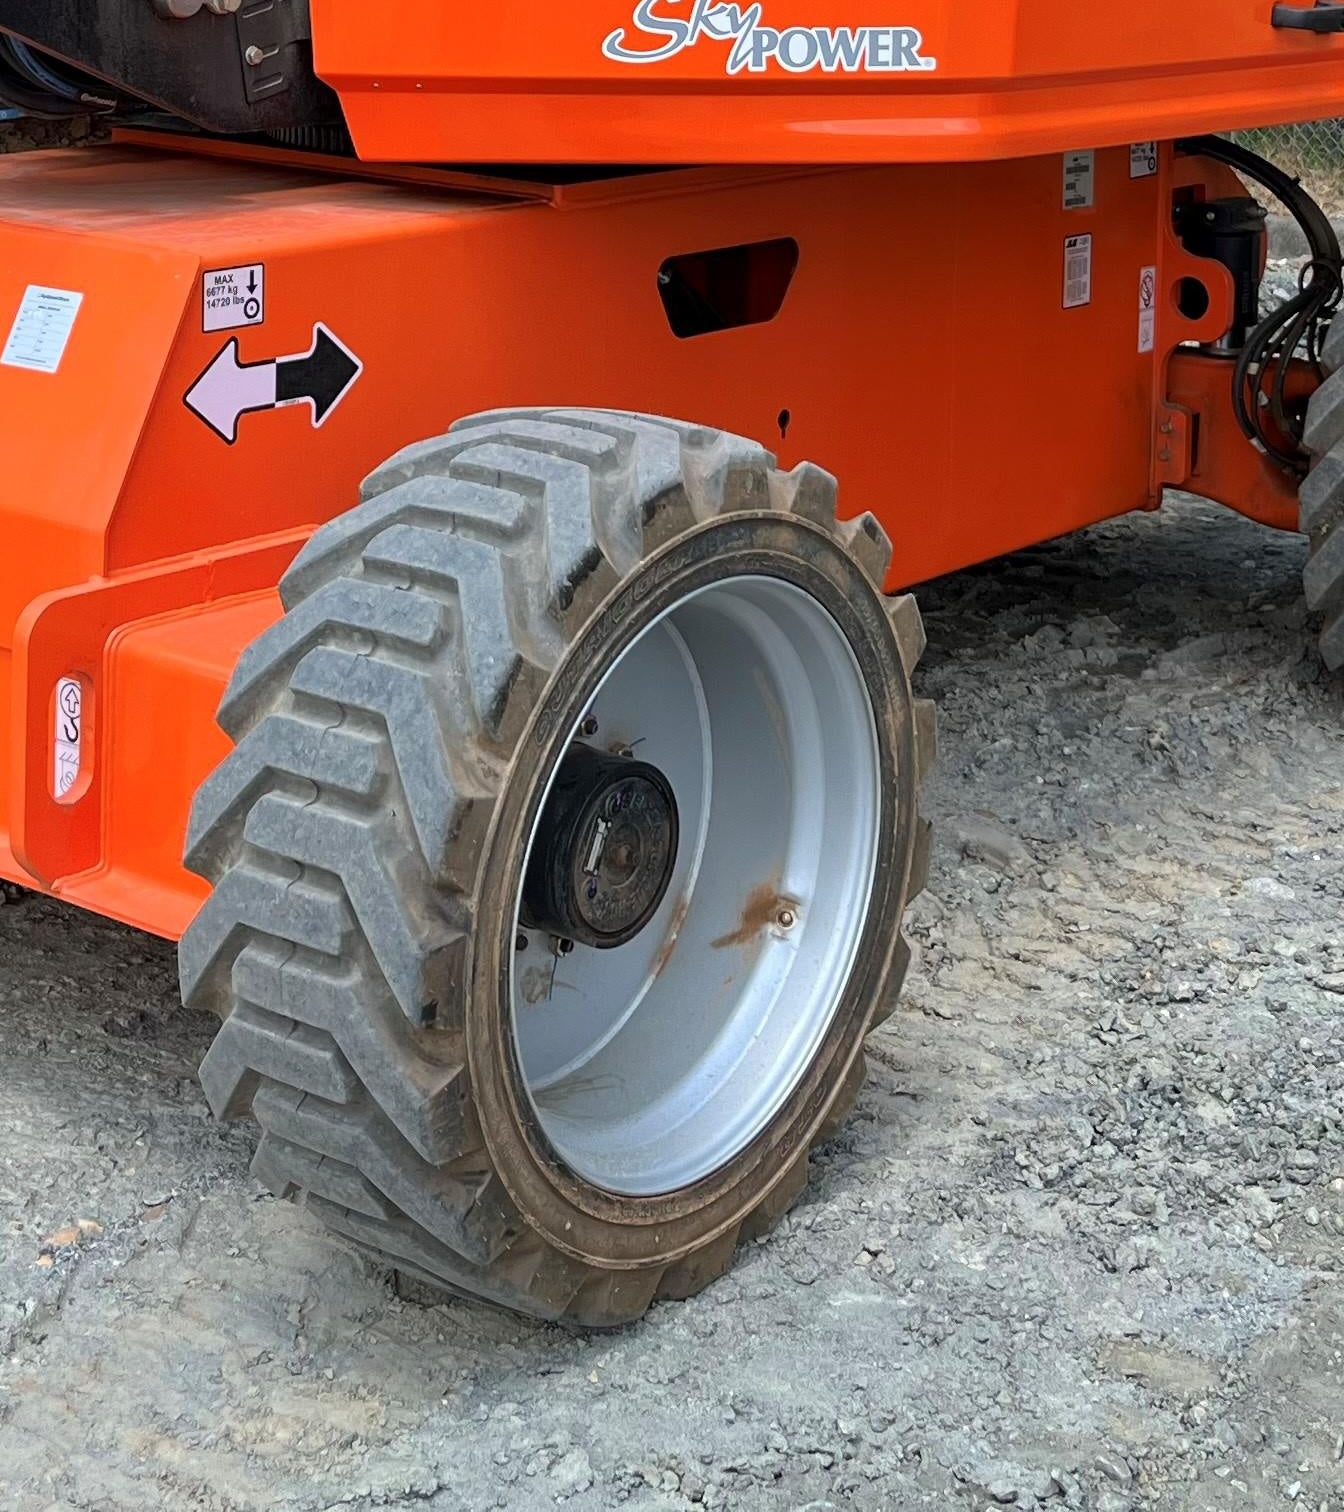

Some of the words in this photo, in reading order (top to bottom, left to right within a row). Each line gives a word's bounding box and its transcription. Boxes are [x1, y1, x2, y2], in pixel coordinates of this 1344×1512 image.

[214, 274, 234, 285] MAX
[227, 285, 238, 295] kg
[206, 297, 231, 309] 14720
[232, 296, 245, 304] lbs
